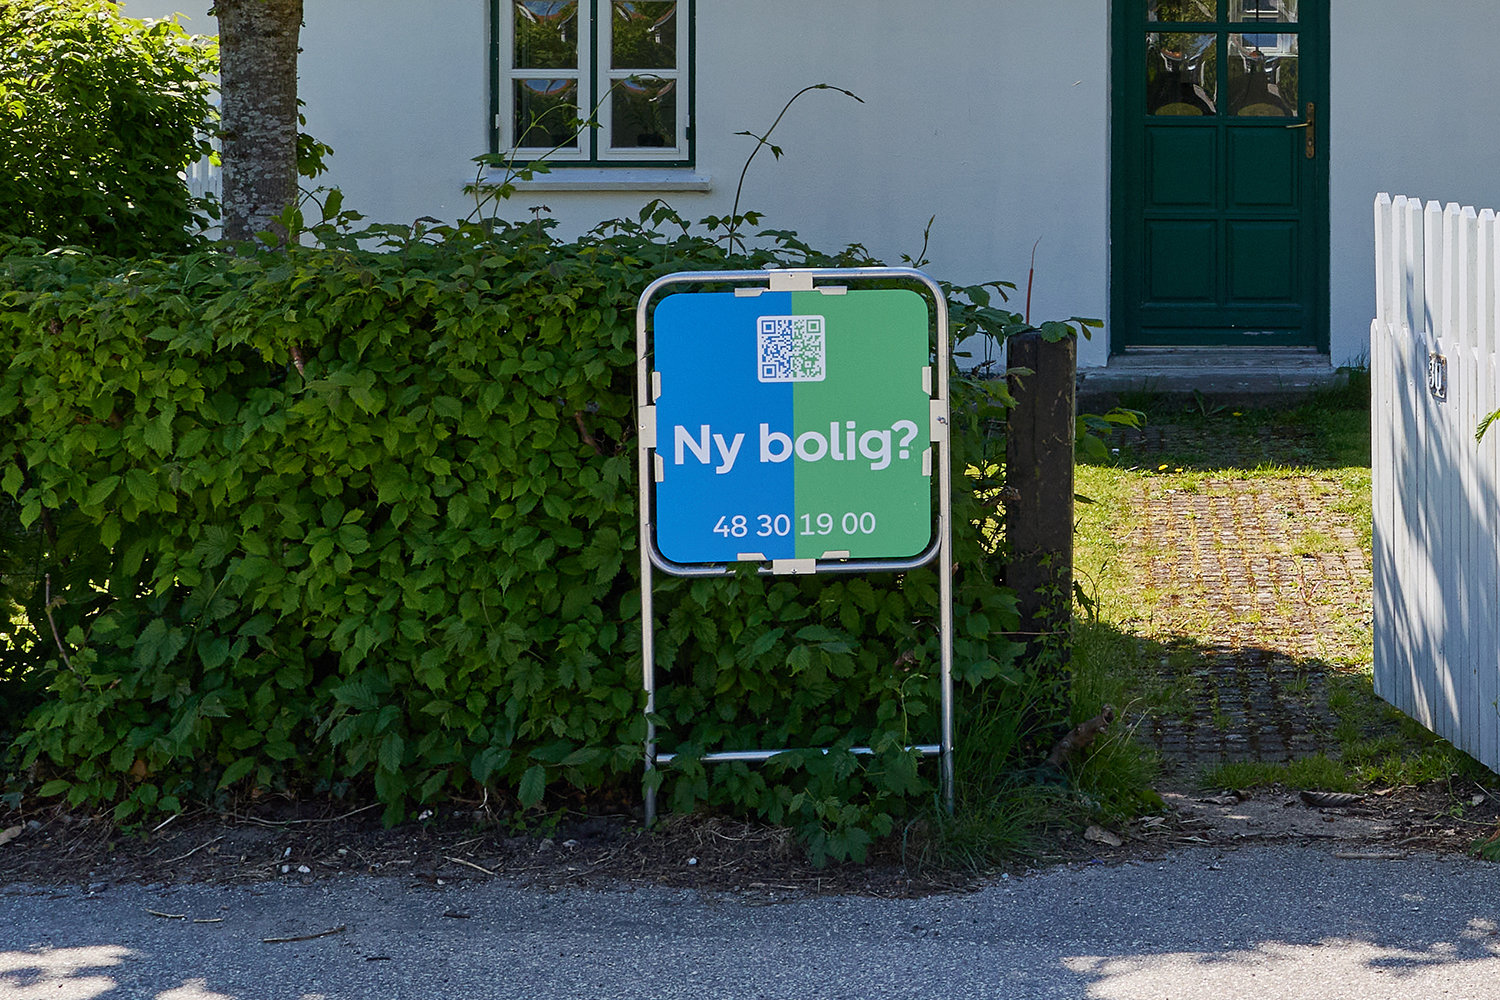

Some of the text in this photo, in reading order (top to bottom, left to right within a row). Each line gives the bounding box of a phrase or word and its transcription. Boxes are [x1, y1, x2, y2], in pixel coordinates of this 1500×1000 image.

[675, 420, 918, 474] Ny bolig?
[714, 512, 875, 537] 48 30 19 00
